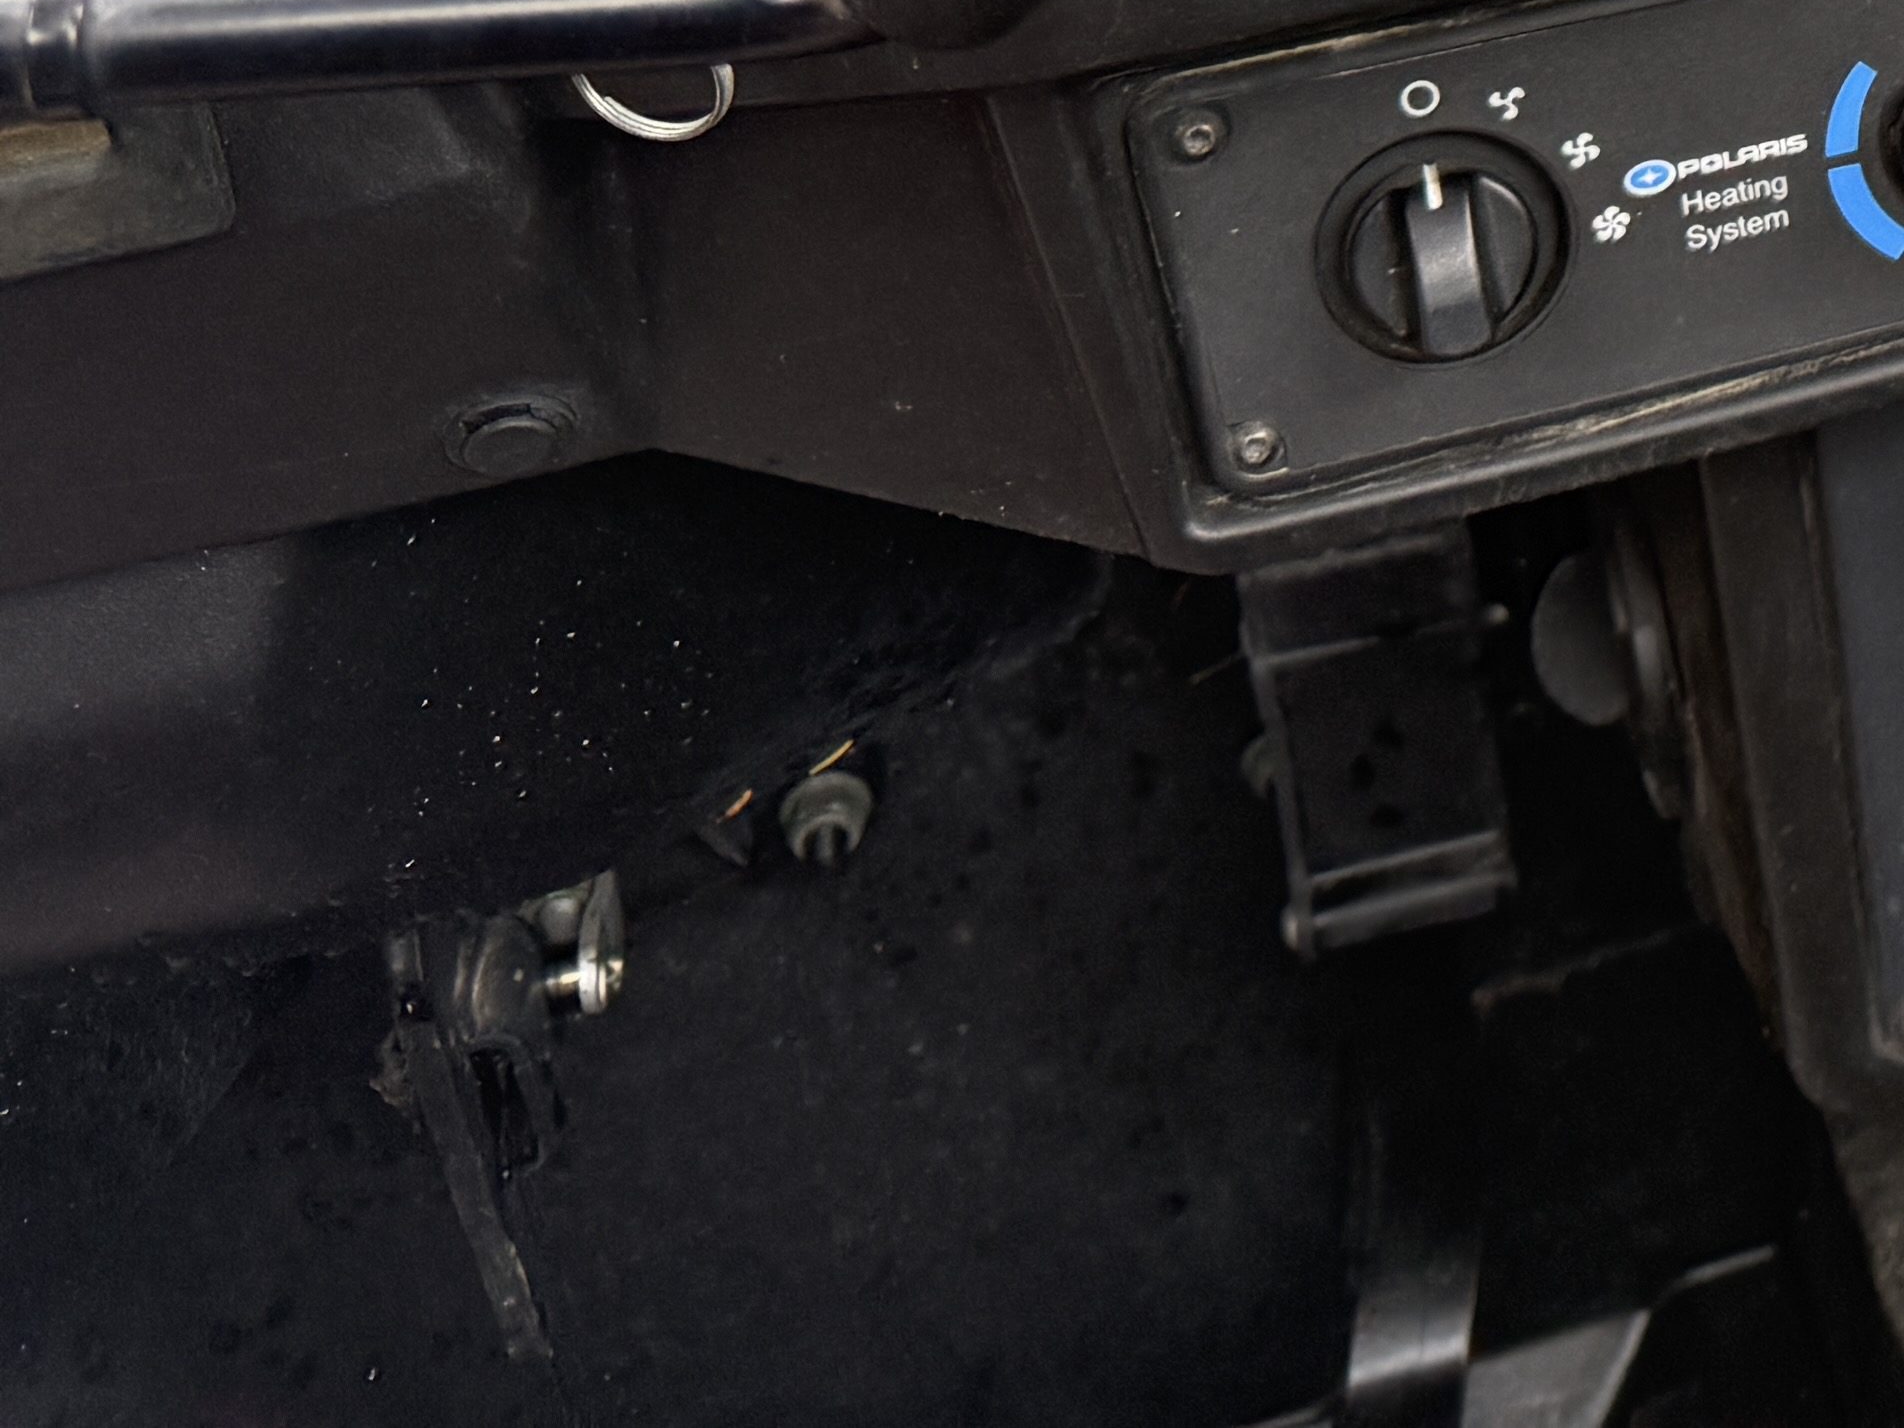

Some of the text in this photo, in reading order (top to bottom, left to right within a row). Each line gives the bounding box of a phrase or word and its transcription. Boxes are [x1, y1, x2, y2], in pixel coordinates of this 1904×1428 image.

[1676, 133, 1809, 181] POLARIS
[1680, 175, 1789, 218] Heating
[1685, 209, 1790, 254] System
